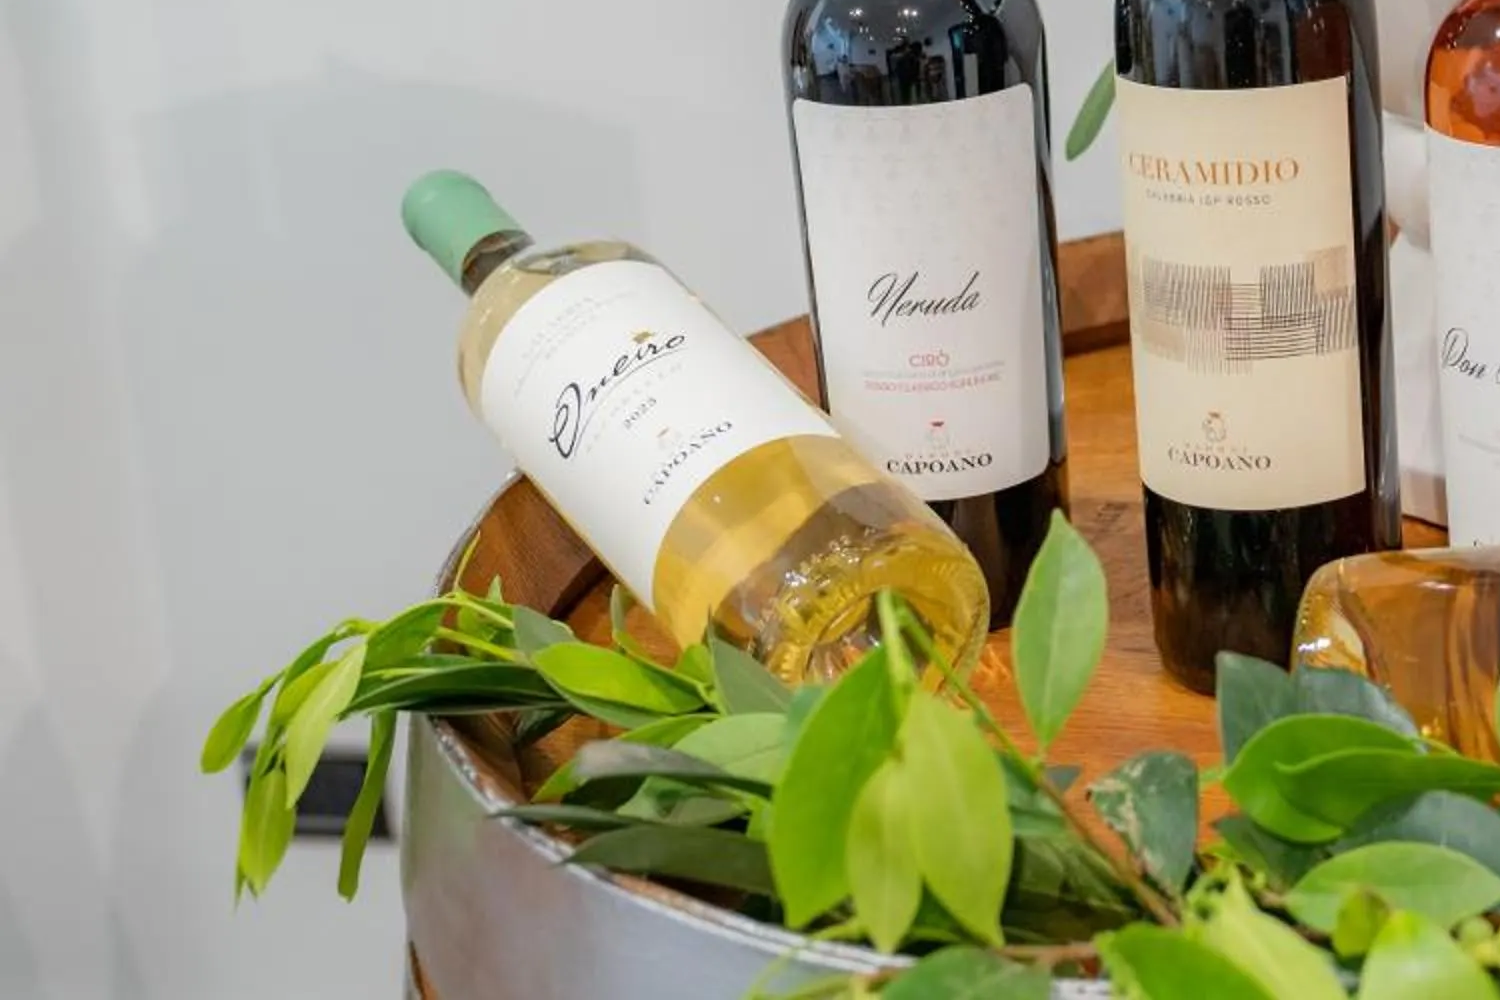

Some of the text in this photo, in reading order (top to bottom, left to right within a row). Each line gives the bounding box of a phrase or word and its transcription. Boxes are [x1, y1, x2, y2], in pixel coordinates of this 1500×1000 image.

[1129, 153, 1300, 185] CERAMIDIO
[868, 271, 980, 327] Neruda
[1441, 327, 1488, 379] Don
[548, 335, 685, 459] Oneiro
[642, 419, 733, 506] CAPOANO
[887, 453, 993, 475] CAPOANO
[1167, 446, 1272, 470] CAPOANO
